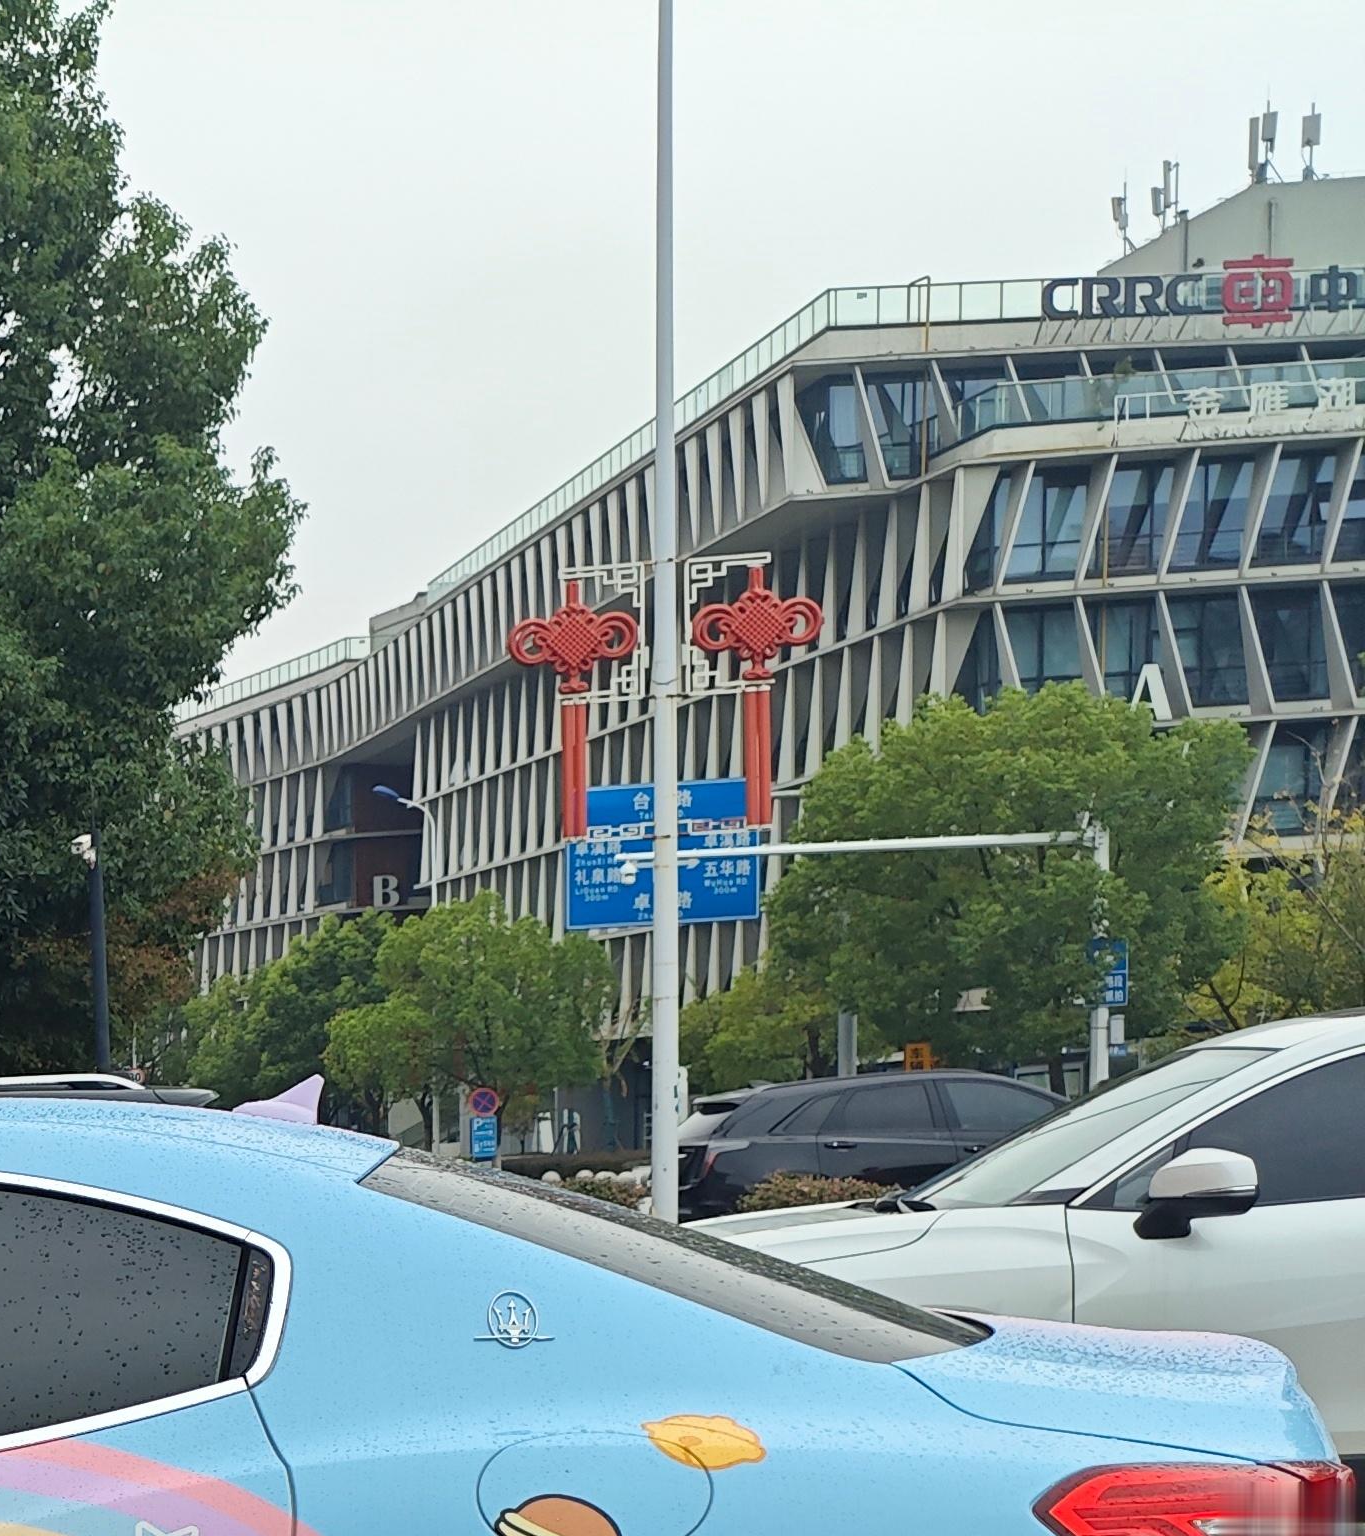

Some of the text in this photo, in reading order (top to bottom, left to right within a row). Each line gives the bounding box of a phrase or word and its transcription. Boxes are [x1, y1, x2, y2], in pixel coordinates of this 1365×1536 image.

[1042, 275, 1203, 319] CRRC
[1130, 663, 1173, 721] A
[703, 859, 751, 878] 五华路
[373, 875, 400, 908] B
